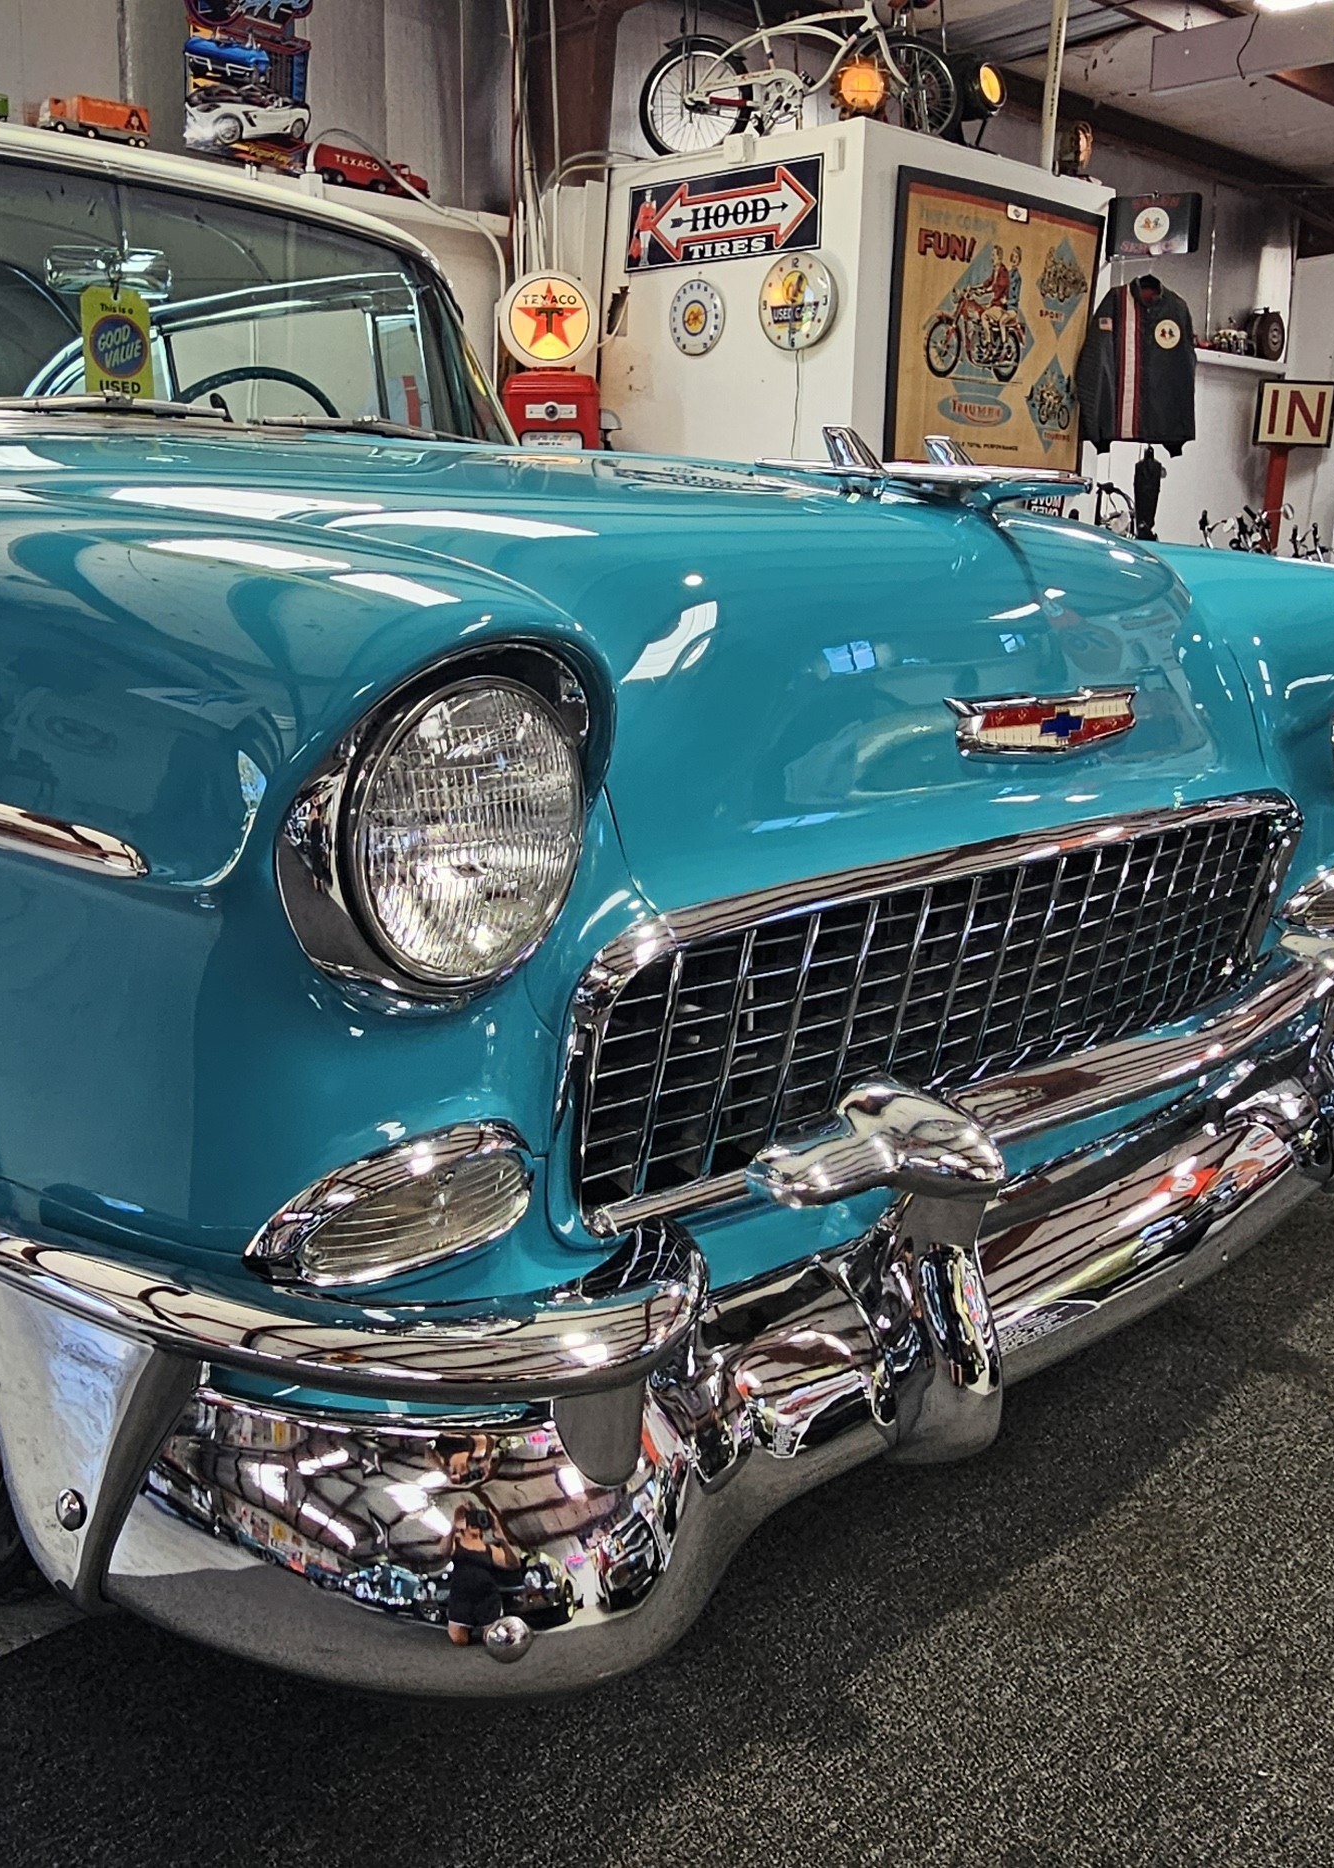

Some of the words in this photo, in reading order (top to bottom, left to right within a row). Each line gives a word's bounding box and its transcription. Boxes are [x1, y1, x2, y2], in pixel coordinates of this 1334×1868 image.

[335, 153, 380, 172] TEXACO
[690, 197, 770, 232] HOOD
[689, 237, 766, 258] TIRES
[918, 227, 977, 263] FUN!
[100, 303, 117, 313] This
[119, 304, 126, 313] is
[522, 294, 577, 305] TEXACO
[98, 324, 131, 352] GOOD
[104, 339, 143, 368] VALUE
[100, 380, 141, 394] USED
[951, 398, 1002, 420] TRIUMPH
[1268, 389, 1327, 438] IN
